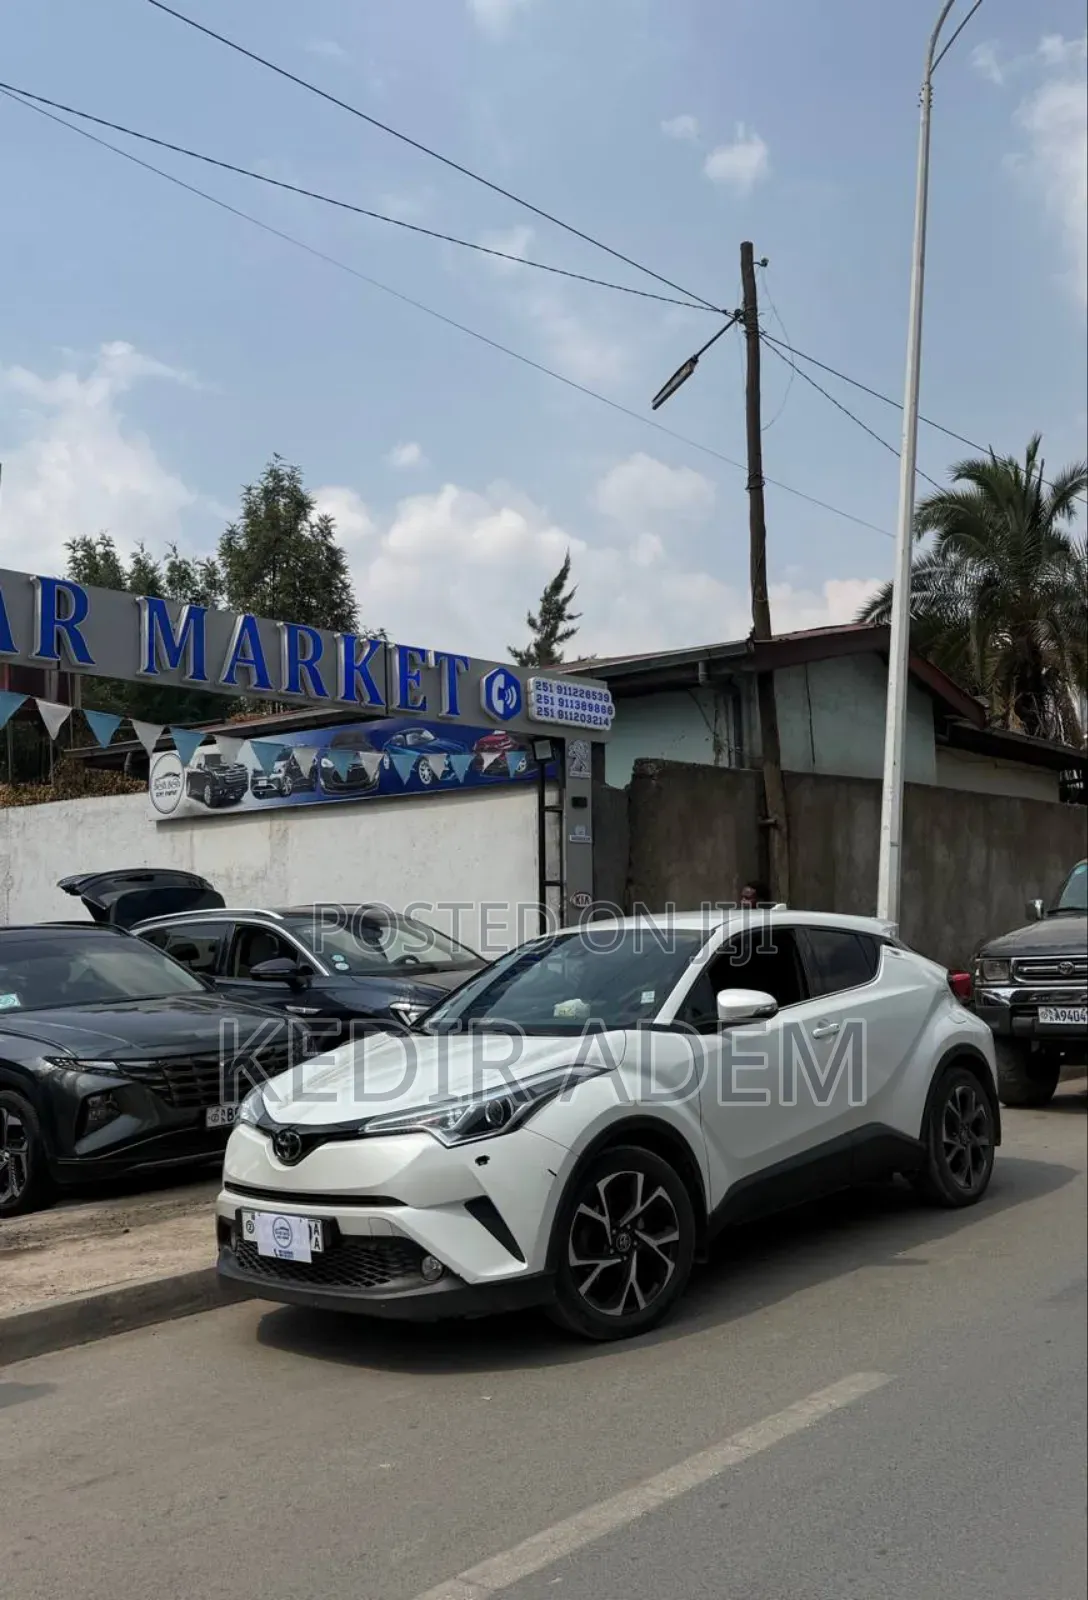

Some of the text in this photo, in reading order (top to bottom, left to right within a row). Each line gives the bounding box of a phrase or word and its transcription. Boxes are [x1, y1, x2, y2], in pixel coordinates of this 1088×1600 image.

[135, 595, 470, 718] MARKET
[535, 681, 553, 693] 251
[536, 694, 555, 706] 251
[536, 706, 555, 718] 251
